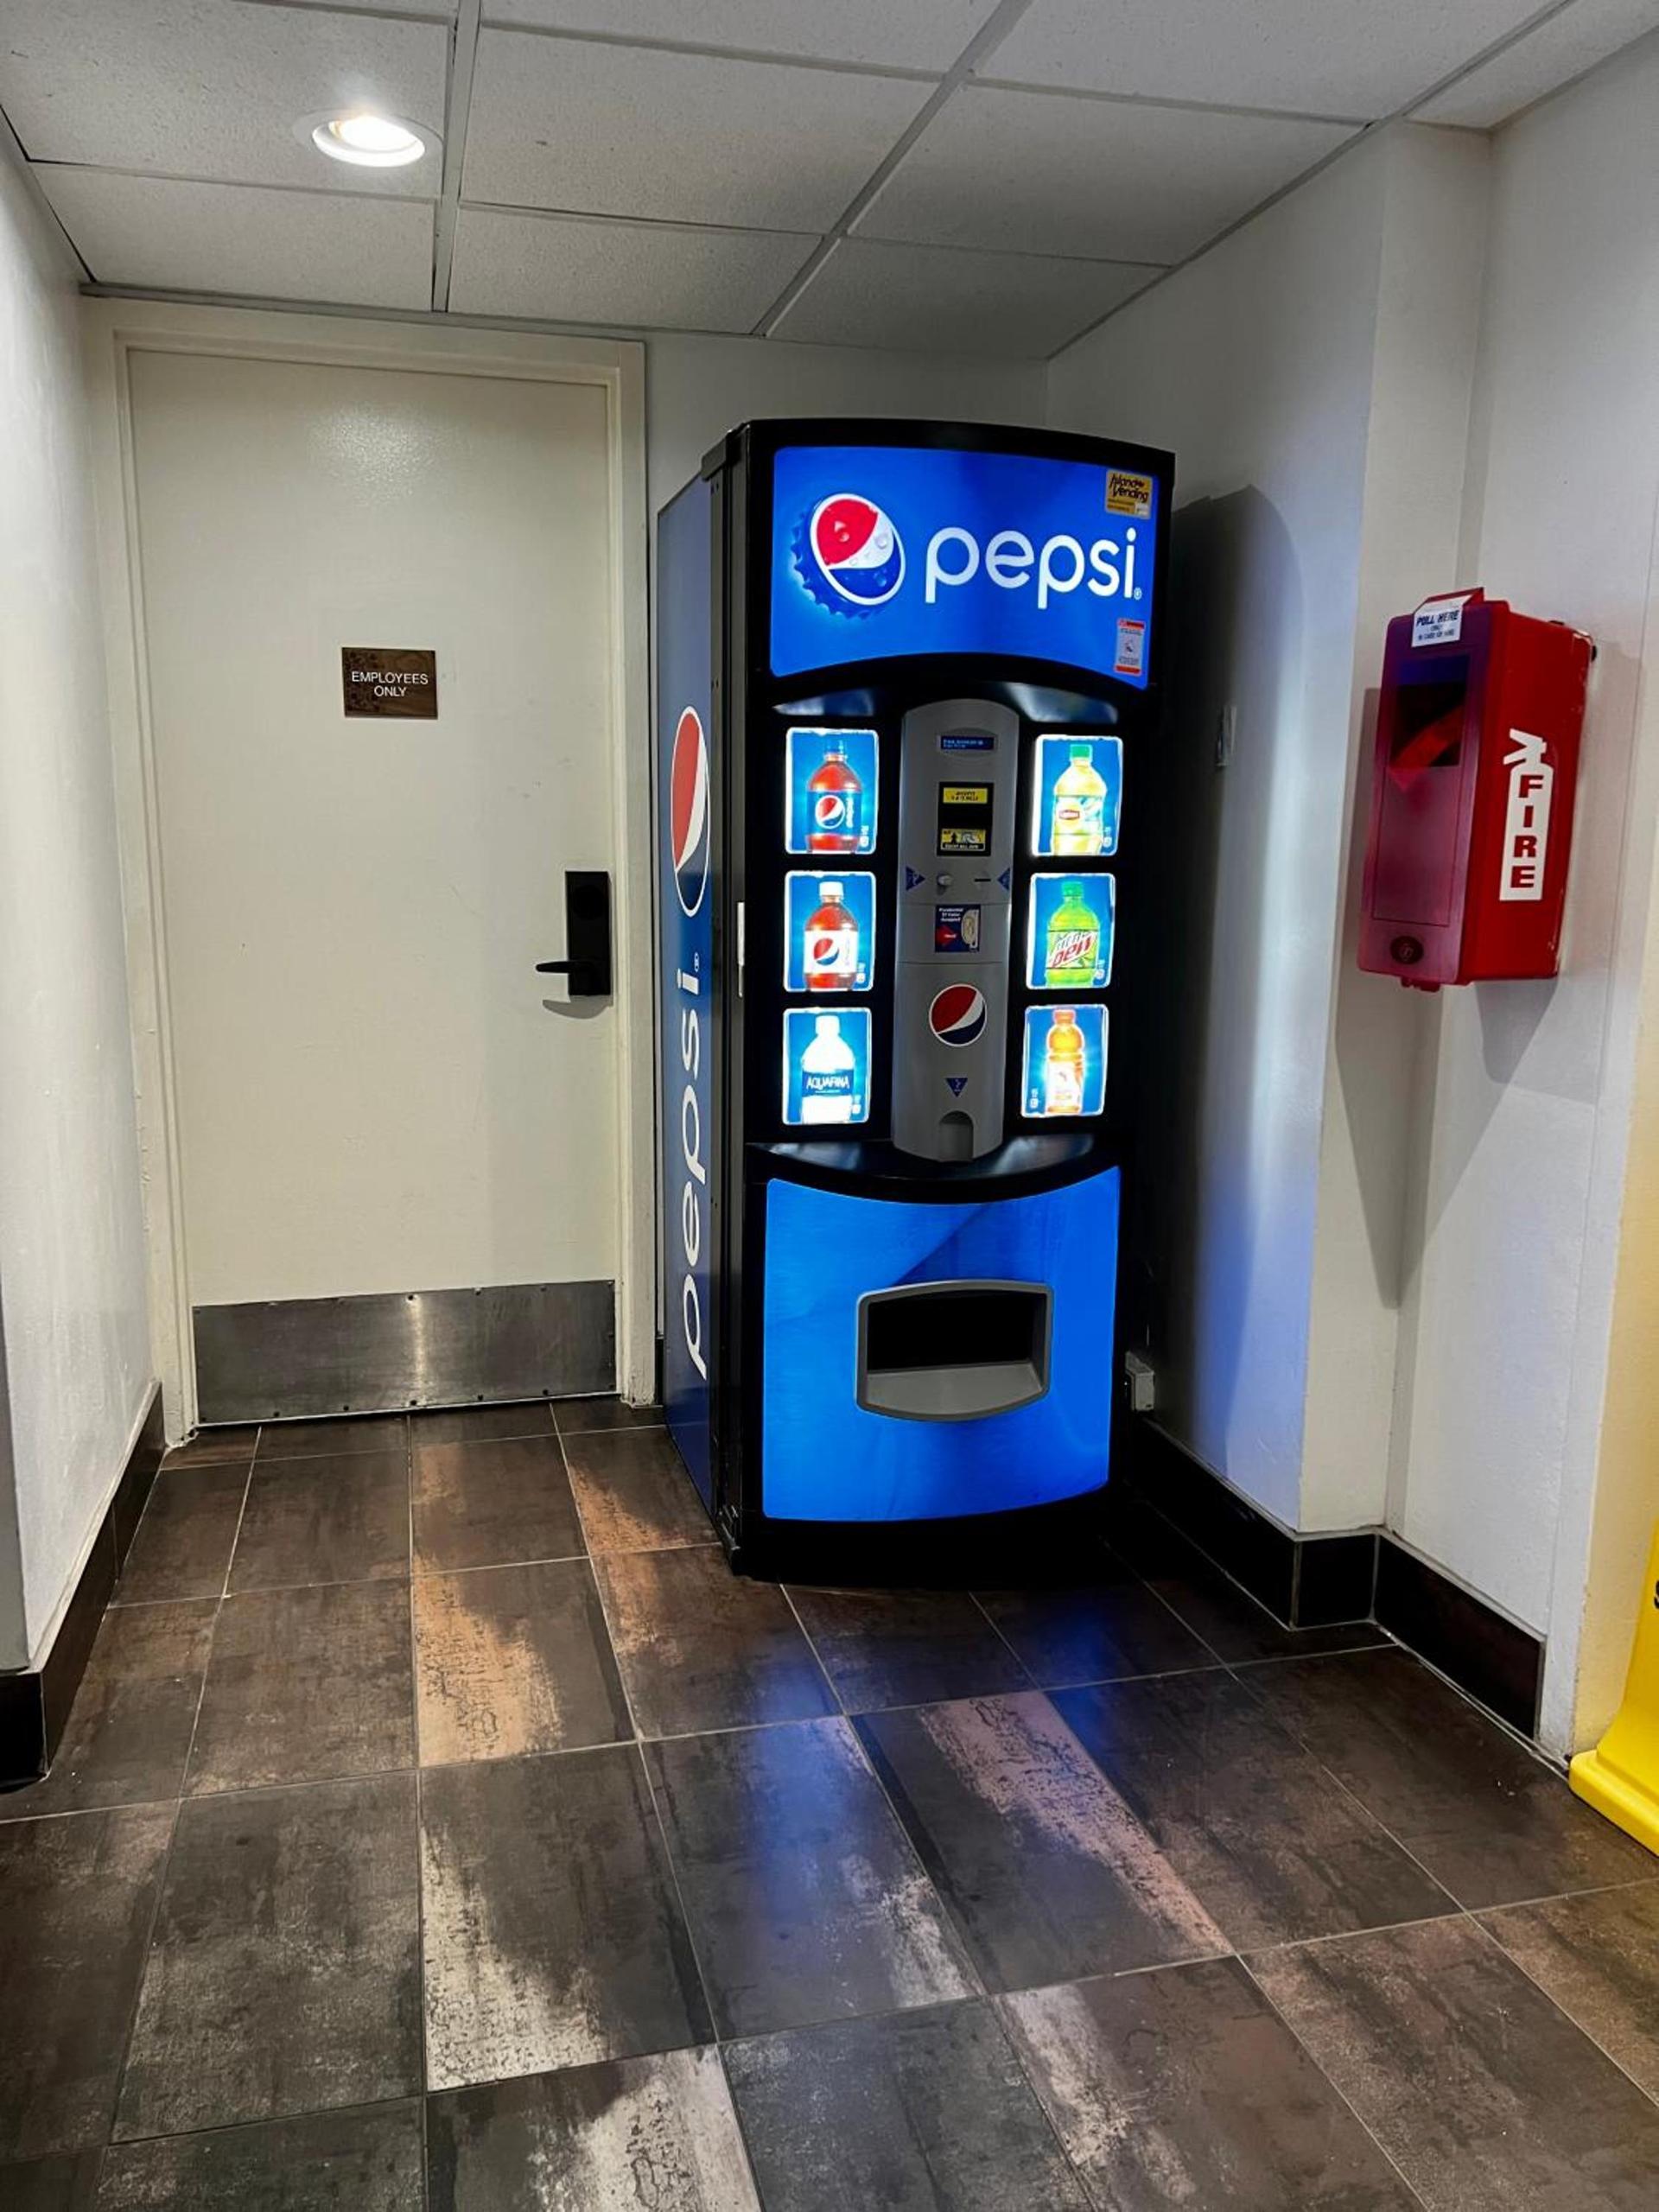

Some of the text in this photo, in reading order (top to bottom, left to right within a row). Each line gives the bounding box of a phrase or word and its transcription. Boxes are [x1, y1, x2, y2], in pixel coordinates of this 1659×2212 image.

[925, 527, 1135, 609] pepsi
[352, 671, 429, 685] EMPLOYEES
[373, 685, 407, 697] ONLY
[1510, 774, 1544, 888] FIRE
[806, 1075, 850, 1090] AQUAFINA
[677, 968, 707, 1380] pepsi
